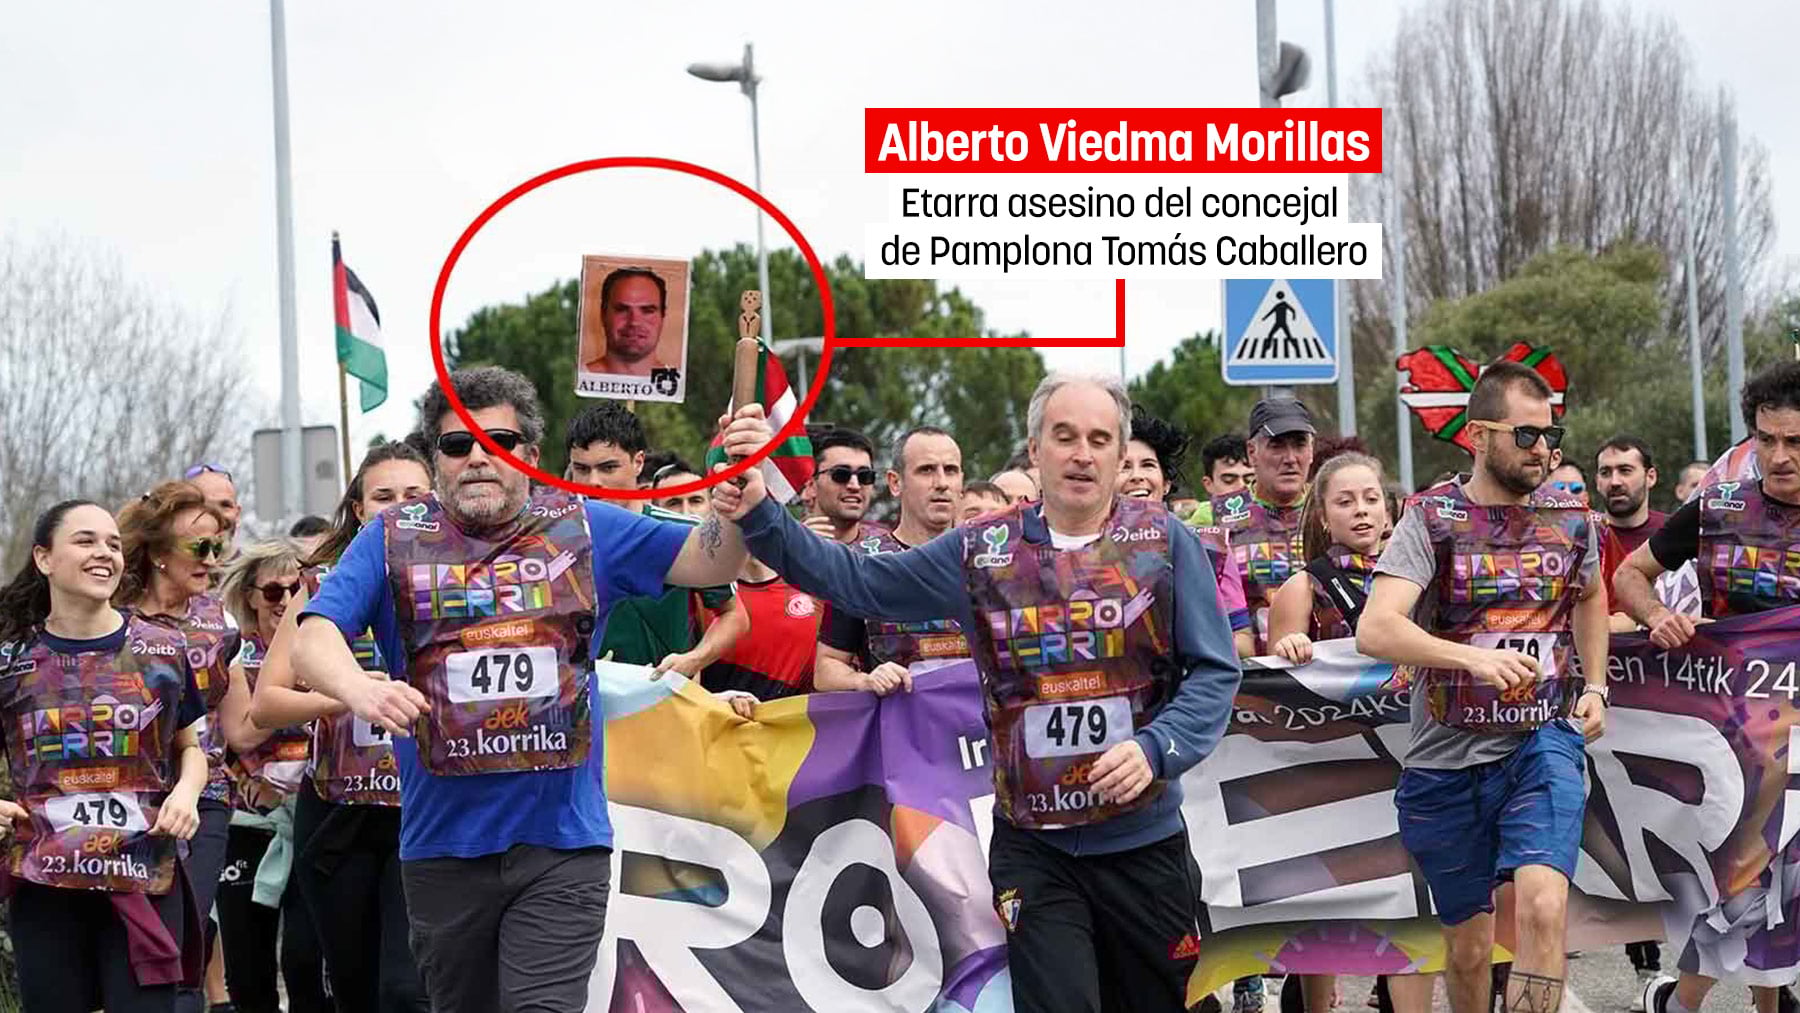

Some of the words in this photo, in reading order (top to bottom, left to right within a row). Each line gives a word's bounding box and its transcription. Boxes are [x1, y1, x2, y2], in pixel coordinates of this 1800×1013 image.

[579, 379, 653, 396] ALBERTO
[1129, 527, 1161, 541] eitb
[466, 626, 529, 641] euskaltel
[147, 644, 177, 656] eitb
[471, 653, 534, 694] 479
[1041, 675, 1101, 695] euskaltel
[1656, 651, 1734, 696] 14tik
[1744, 659, 1800, 700] 24
[484, 698, 528, 729] aek
[1046, 705, 1107, 747] 479
[447, 724, 567, 758] 23.korrika
[63, 771, 116, 786] euskaltel
[72, 799, 128, 826] 479
[41, 850, 149, 881] 23.korrika
